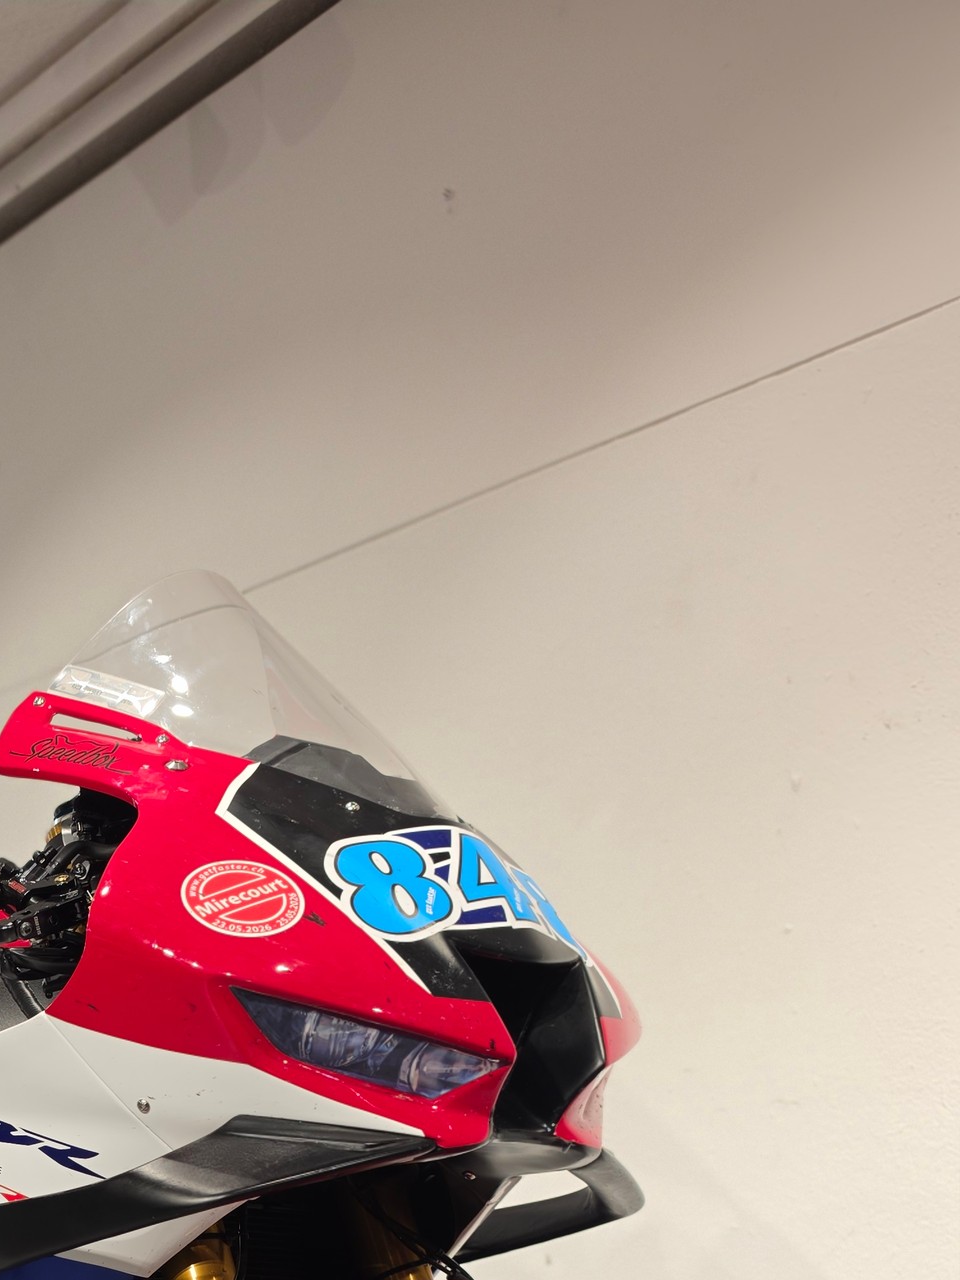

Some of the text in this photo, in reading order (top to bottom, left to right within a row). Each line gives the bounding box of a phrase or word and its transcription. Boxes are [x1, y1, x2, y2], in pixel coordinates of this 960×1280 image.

[189, 864, 265, 897] www.getfaster.ch
[195, 879, 288, 918] Mirecourt
[211, 918, 272, 934] 23.05.2026
